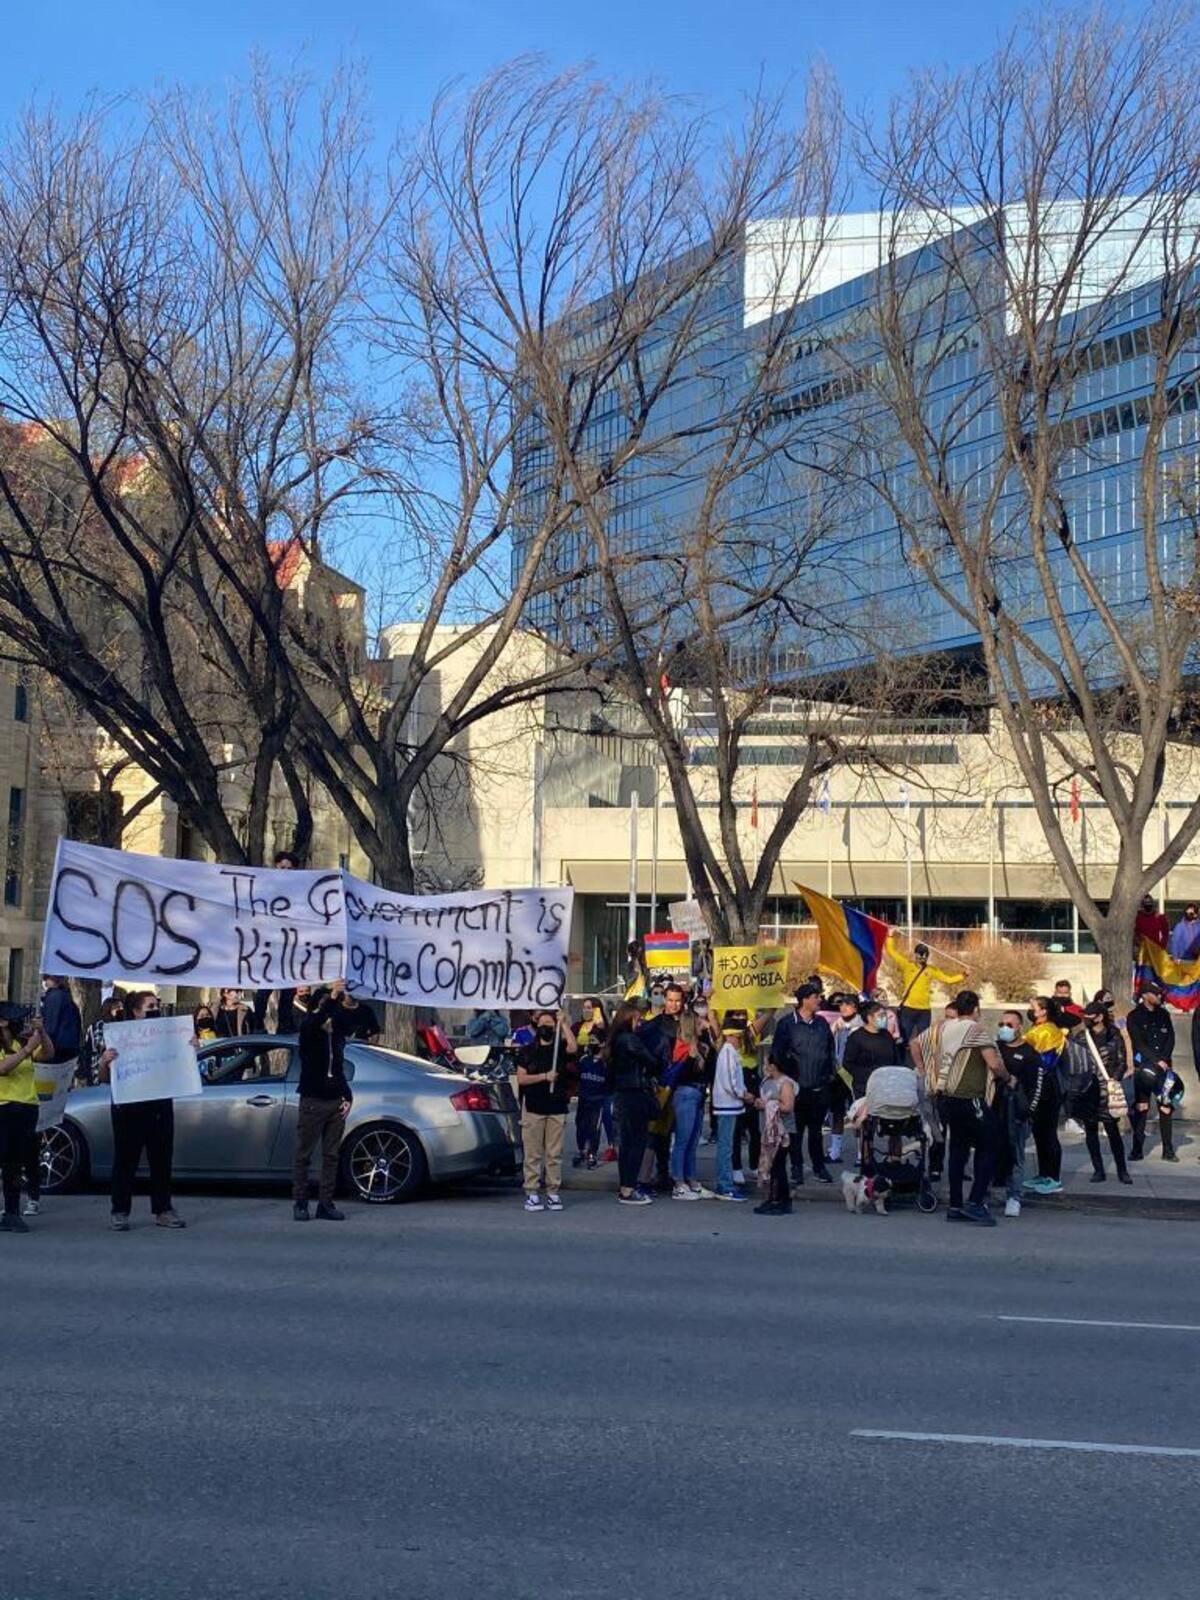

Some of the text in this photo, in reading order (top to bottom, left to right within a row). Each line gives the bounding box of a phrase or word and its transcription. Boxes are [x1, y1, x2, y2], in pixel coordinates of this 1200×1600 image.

[53, 867, 202, 976] SOS
[220, 870, 566, 941] The Government is
[722, 971, 785, 990] COLOMBIA
